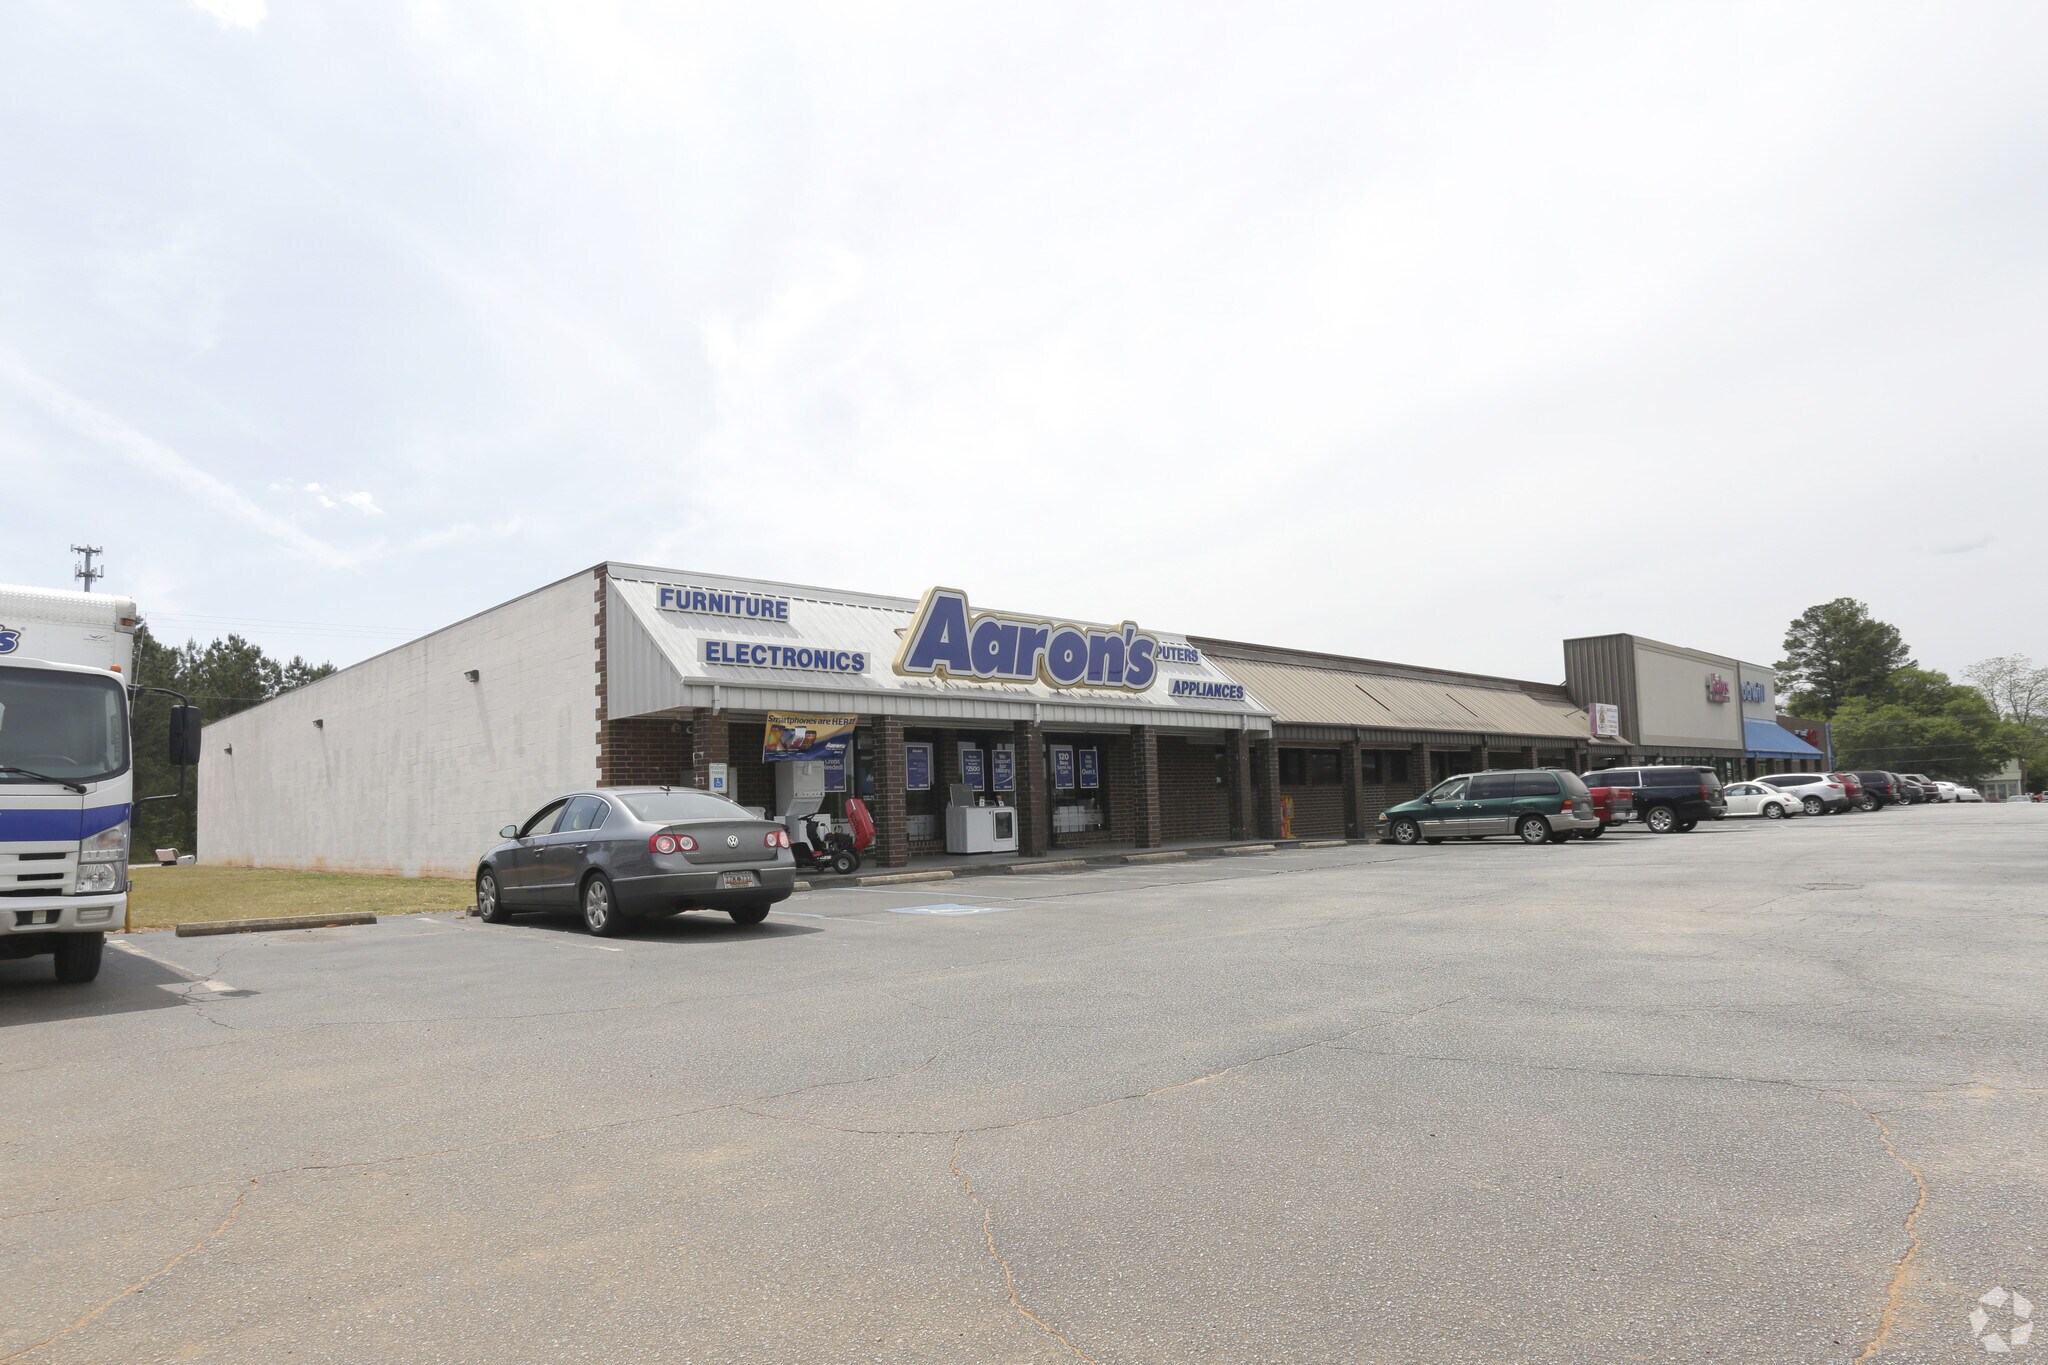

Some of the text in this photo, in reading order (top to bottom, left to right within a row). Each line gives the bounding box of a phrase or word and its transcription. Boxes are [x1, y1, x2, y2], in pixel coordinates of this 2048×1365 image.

[660, 587, 788, 620] FURNITURE
[705, 640, 865, 672] ELECTRONICS
[905, 592, 1156, 688] Aaron's
[1172, 680, 1244, 699] APPLIANCES
[768, 715, 816, 725] Smartphones
